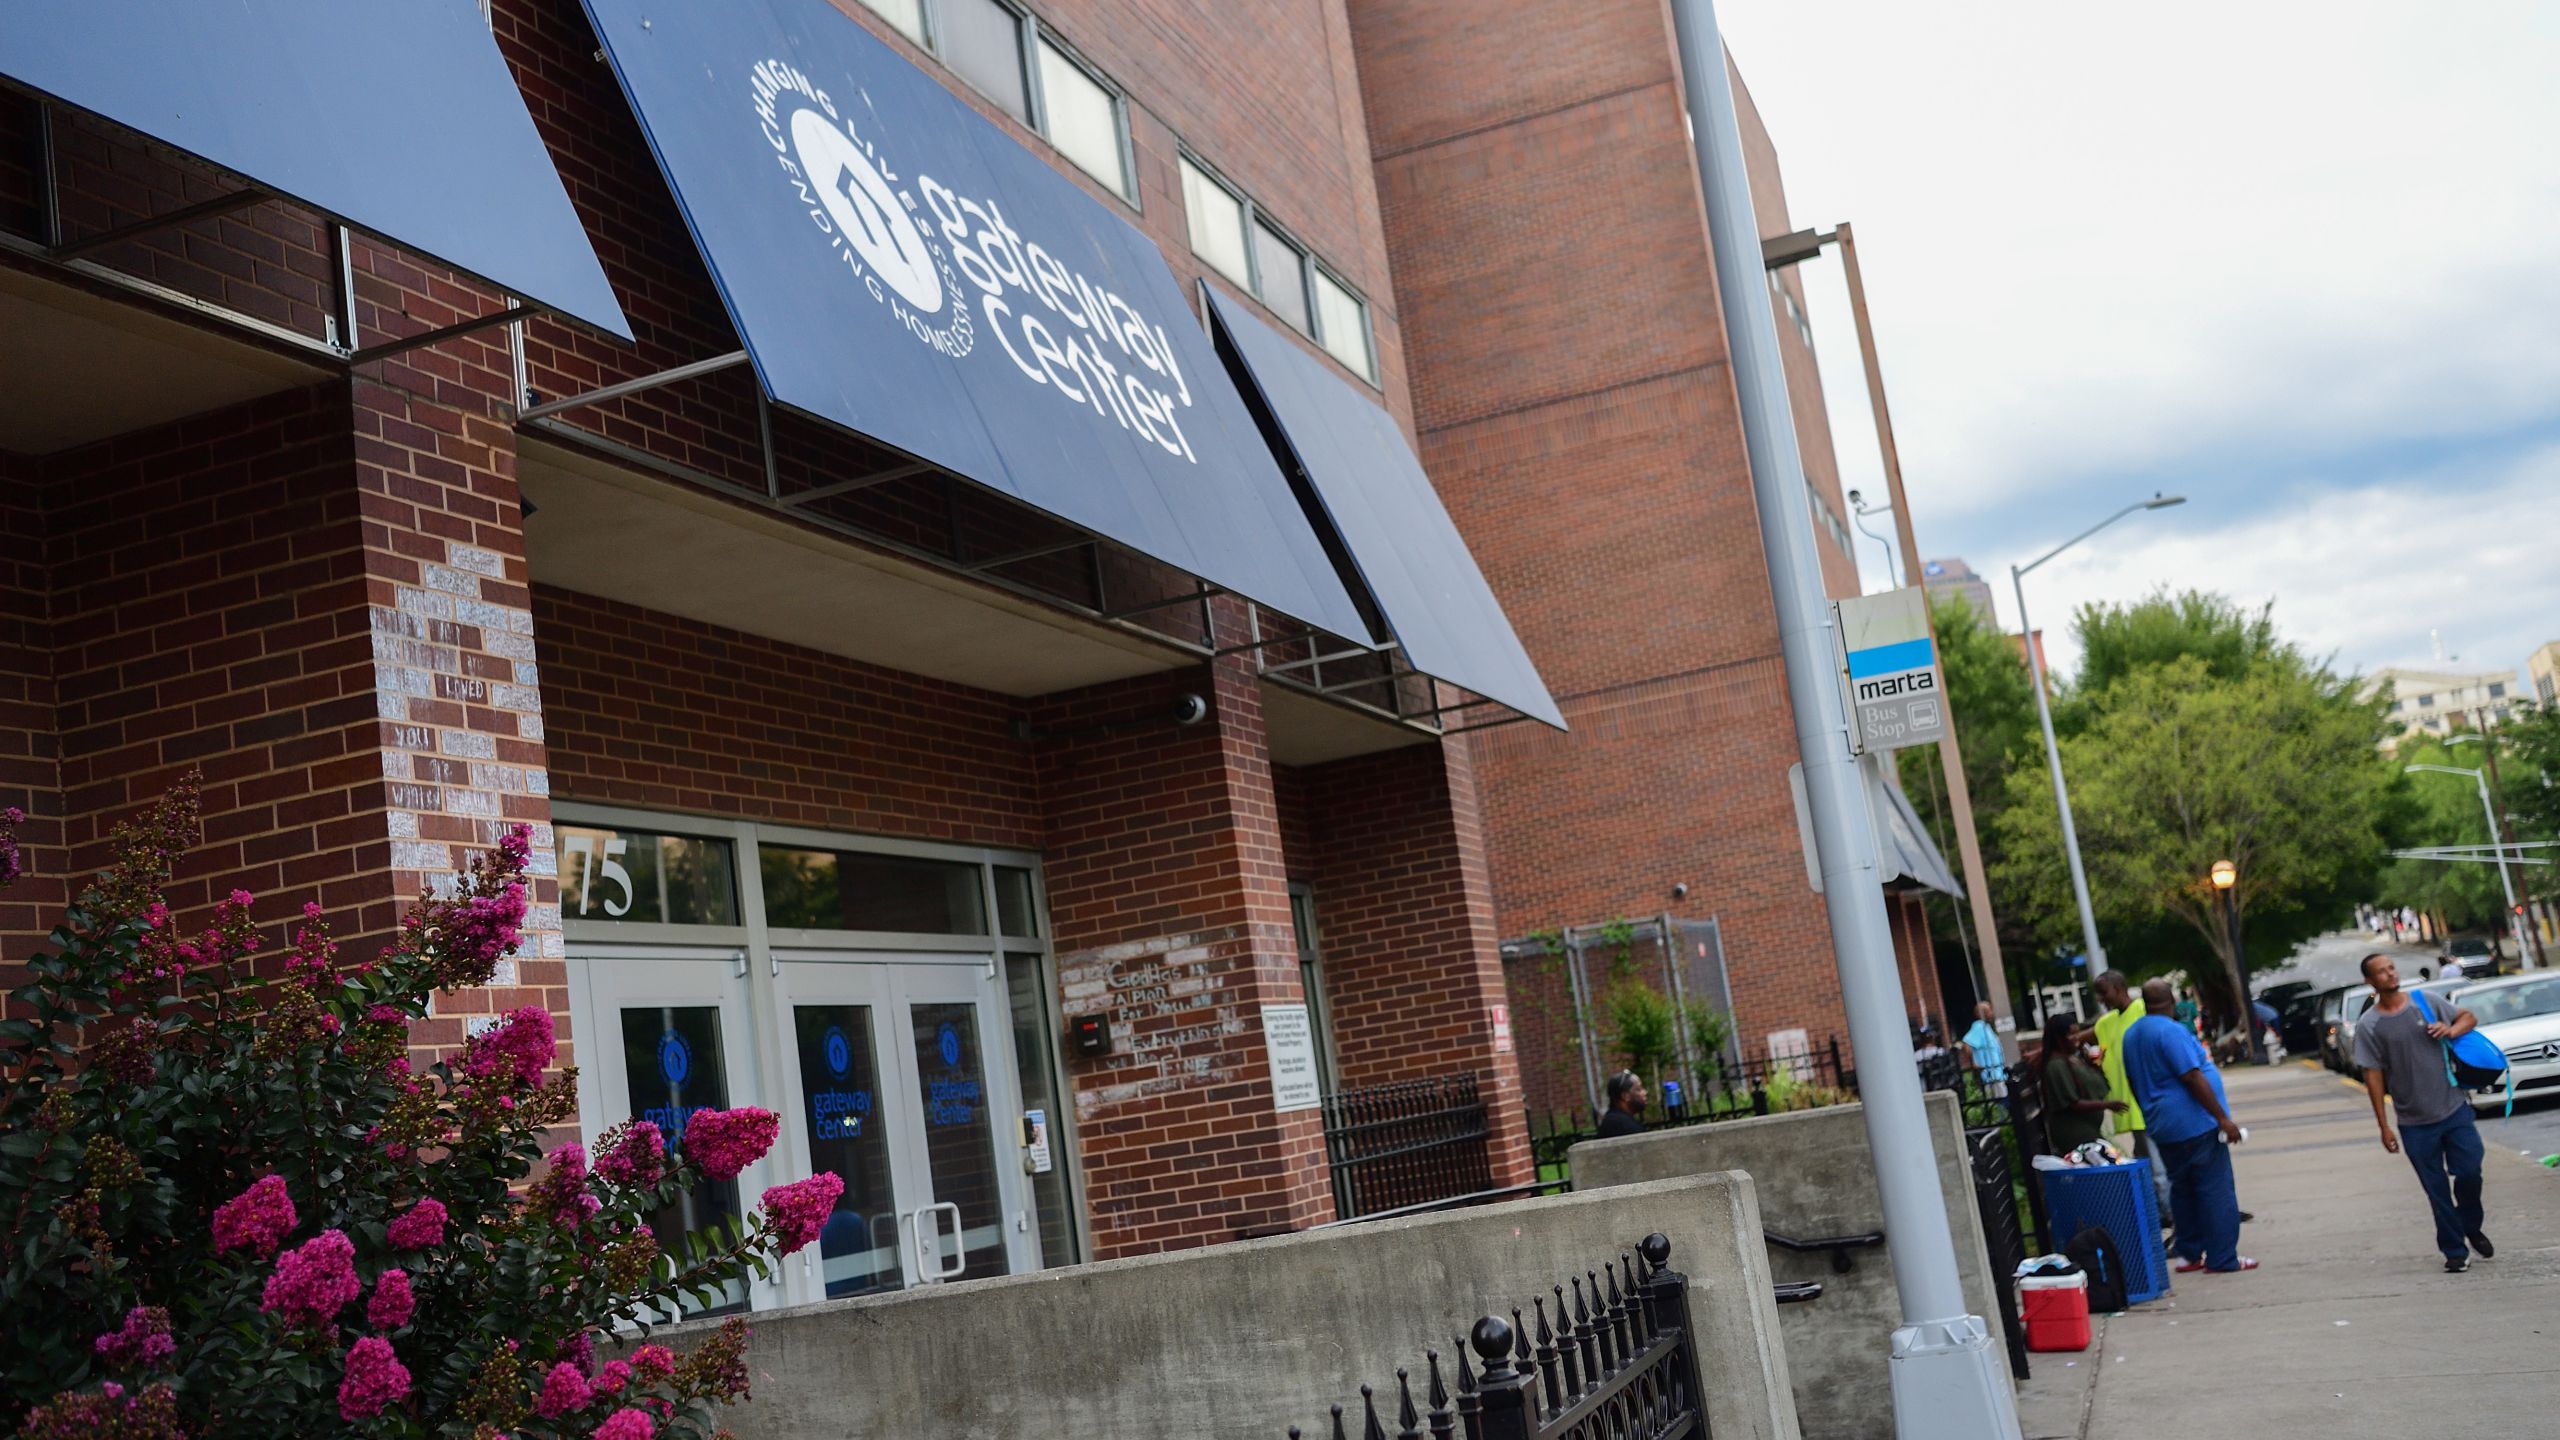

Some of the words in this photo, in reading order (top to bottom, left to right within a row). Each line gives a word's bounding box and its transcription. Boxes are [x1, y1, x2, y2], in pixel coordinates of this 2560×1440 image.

[751, 59, 838, 152] CHANGING
[847, 118, 935, 238] LIVES
[778, 155, 884, 304] ENDING
[890, 241, 974, 358] HOMELESSNESS
[919, 175, 1192, 407] gateway
[982, 294, 1198, 465] center
[1859, 672, 1934, 700] marta
[1865, 706, 1899, 723] Bus
[1867, 722, 1906, 740] Stop
[563, 836, 633, 917] 75
[814, 1088, 872, 1119] gateway
[815, 1113, 862, 1140] center
